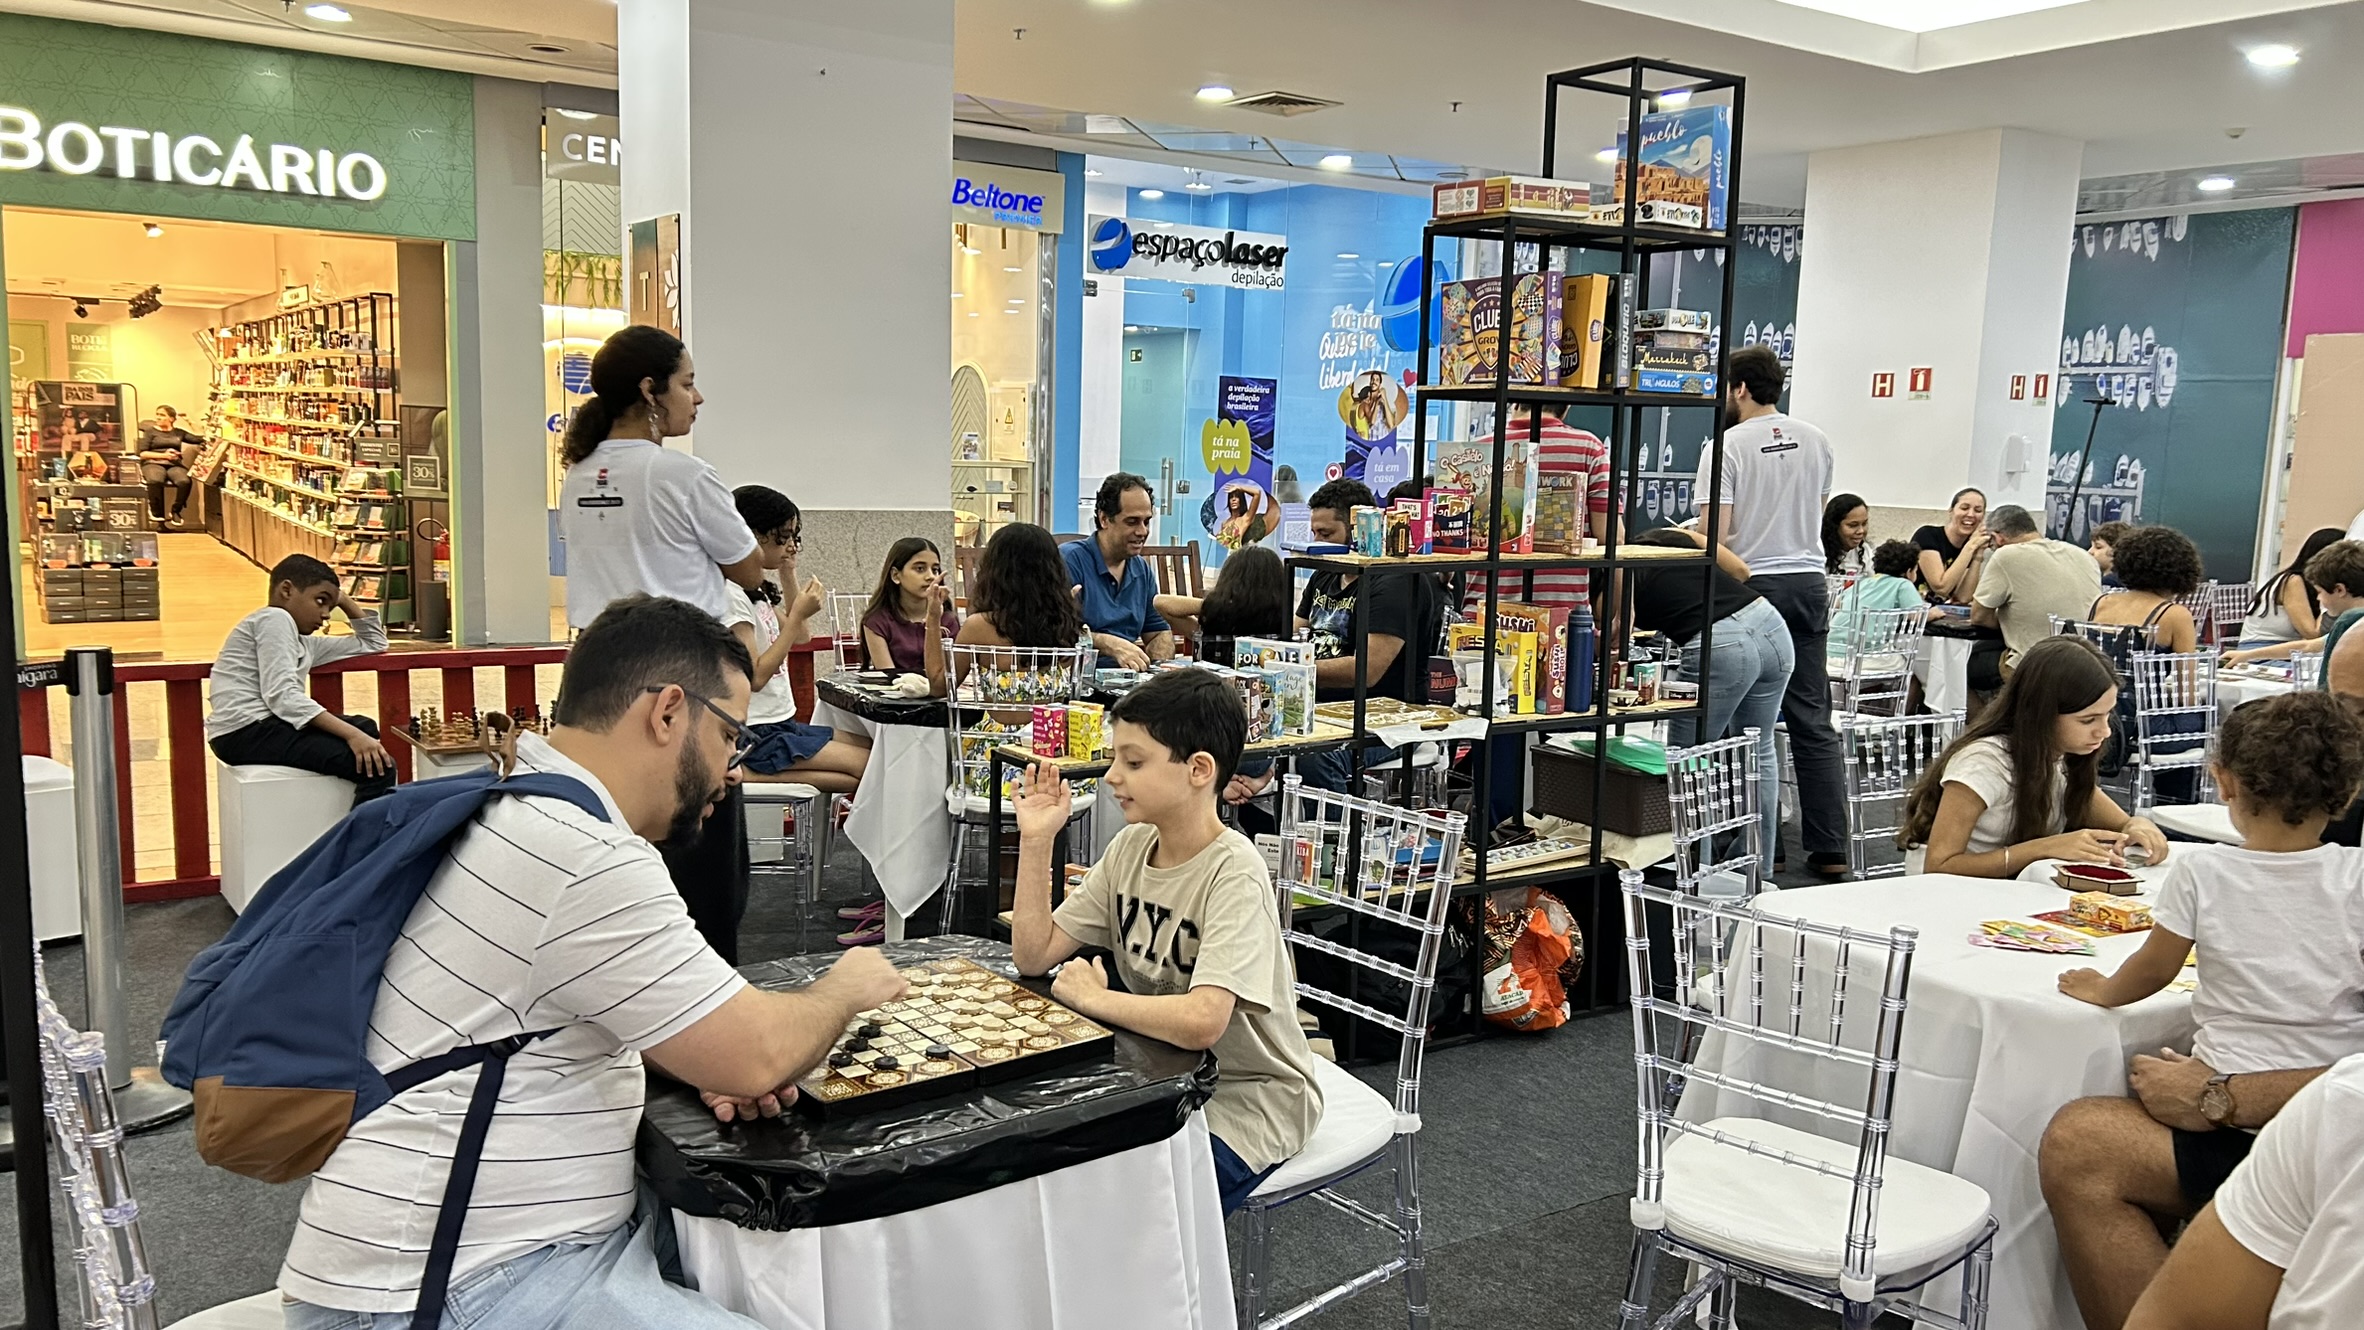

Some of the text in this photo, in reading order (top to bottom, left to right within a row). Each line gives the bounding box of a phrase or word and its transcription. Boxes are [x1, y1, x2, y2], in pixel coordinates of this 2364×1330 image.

[1641, 120, 1688, 155] pueblo
[0, 106, 387, 201] BOTICÁRIO
[952, 178, 1043, 214] Beltone
[1132, 231, 1289, 268] espaçolaser
[1231, 269, 1284, 289] depilação
[1620, 303, 1631, 370] BLOQUEIO
[1234, 385, 1270, 394] verdadeira
[1875, 374, 1892, 397] H
[2012, 377, 2024, 399] H
[1228, 393, 1260, 403] depilação
[1226, 402, 1259, 411] brasileira
[1212, 435, 1240, 447] tá na
[1211, 447, 1241, 461] praia
[1374, 462, 1400, 473] tá em
[1373, 475, 1395, 483] casa
[1237, 653, 1259, 664] FOR
[1501, 990, 1524, 1001] ATACAD
